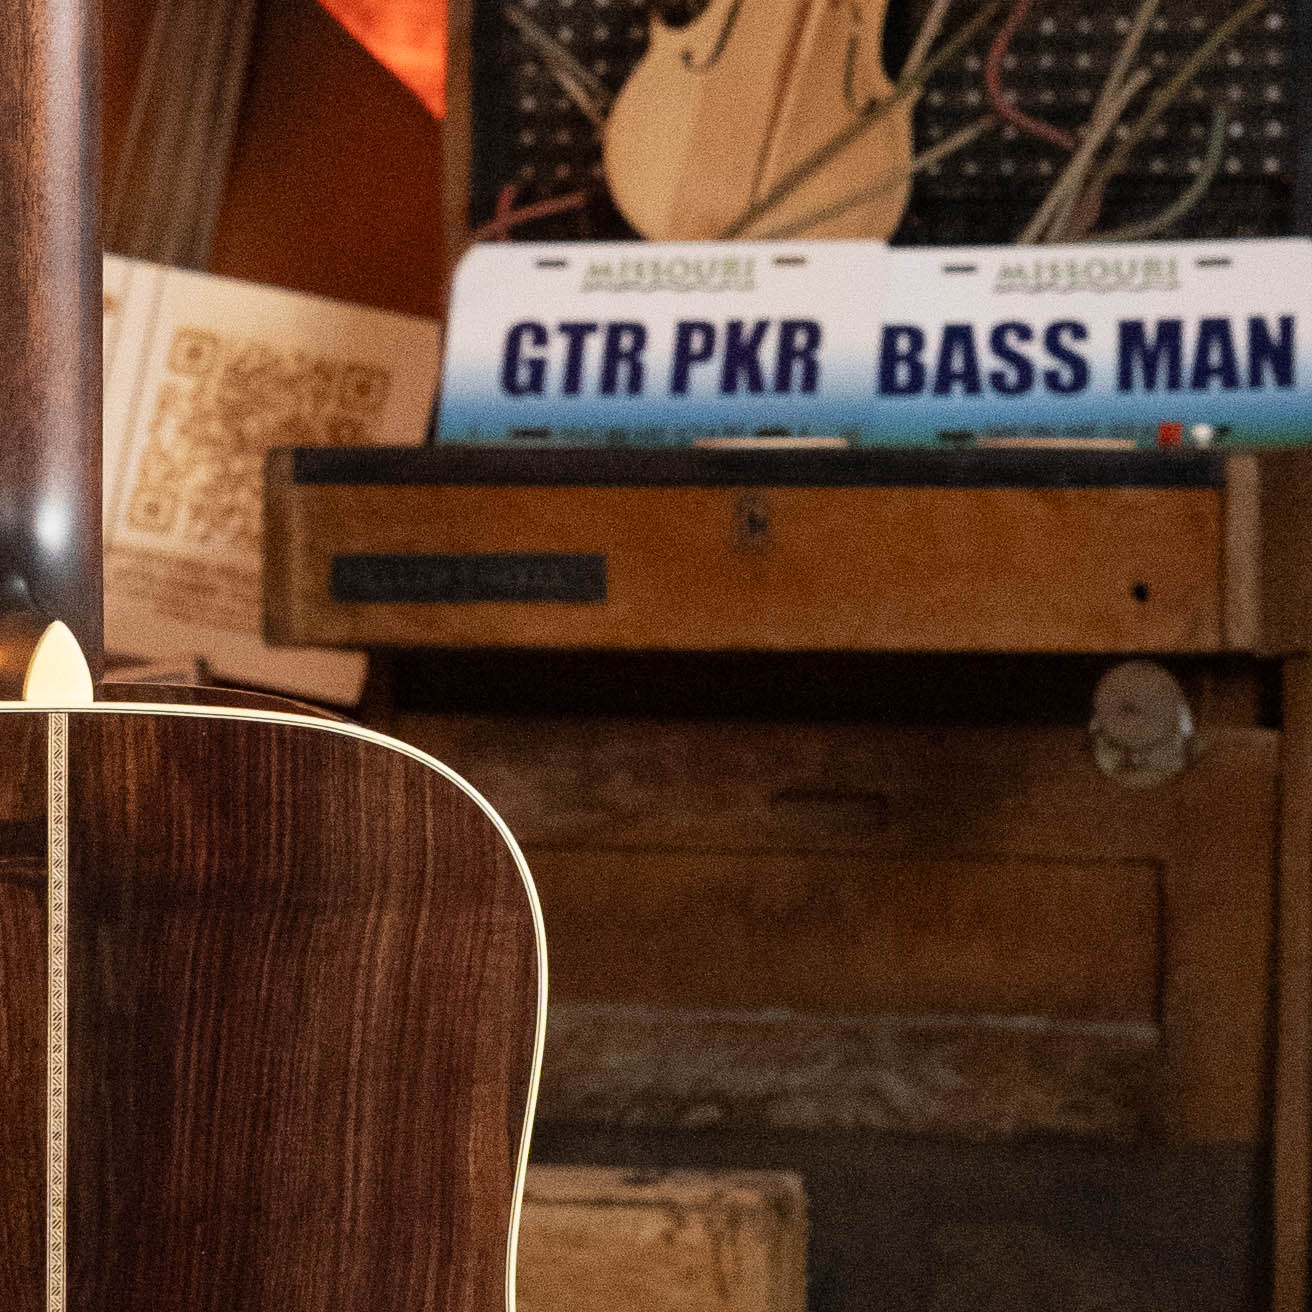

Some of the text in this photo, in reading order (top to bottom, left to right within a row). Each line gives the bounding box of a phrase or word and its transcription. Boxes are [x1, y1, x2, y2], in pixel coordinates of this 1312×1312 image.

[583, 256, 757, 293] MISSOURI
[993, 255, 1182, 294] MISSOURI
[499, 317, 823, 398] GTR PKR
[877, 314, 1296, 397] BASS MAN
